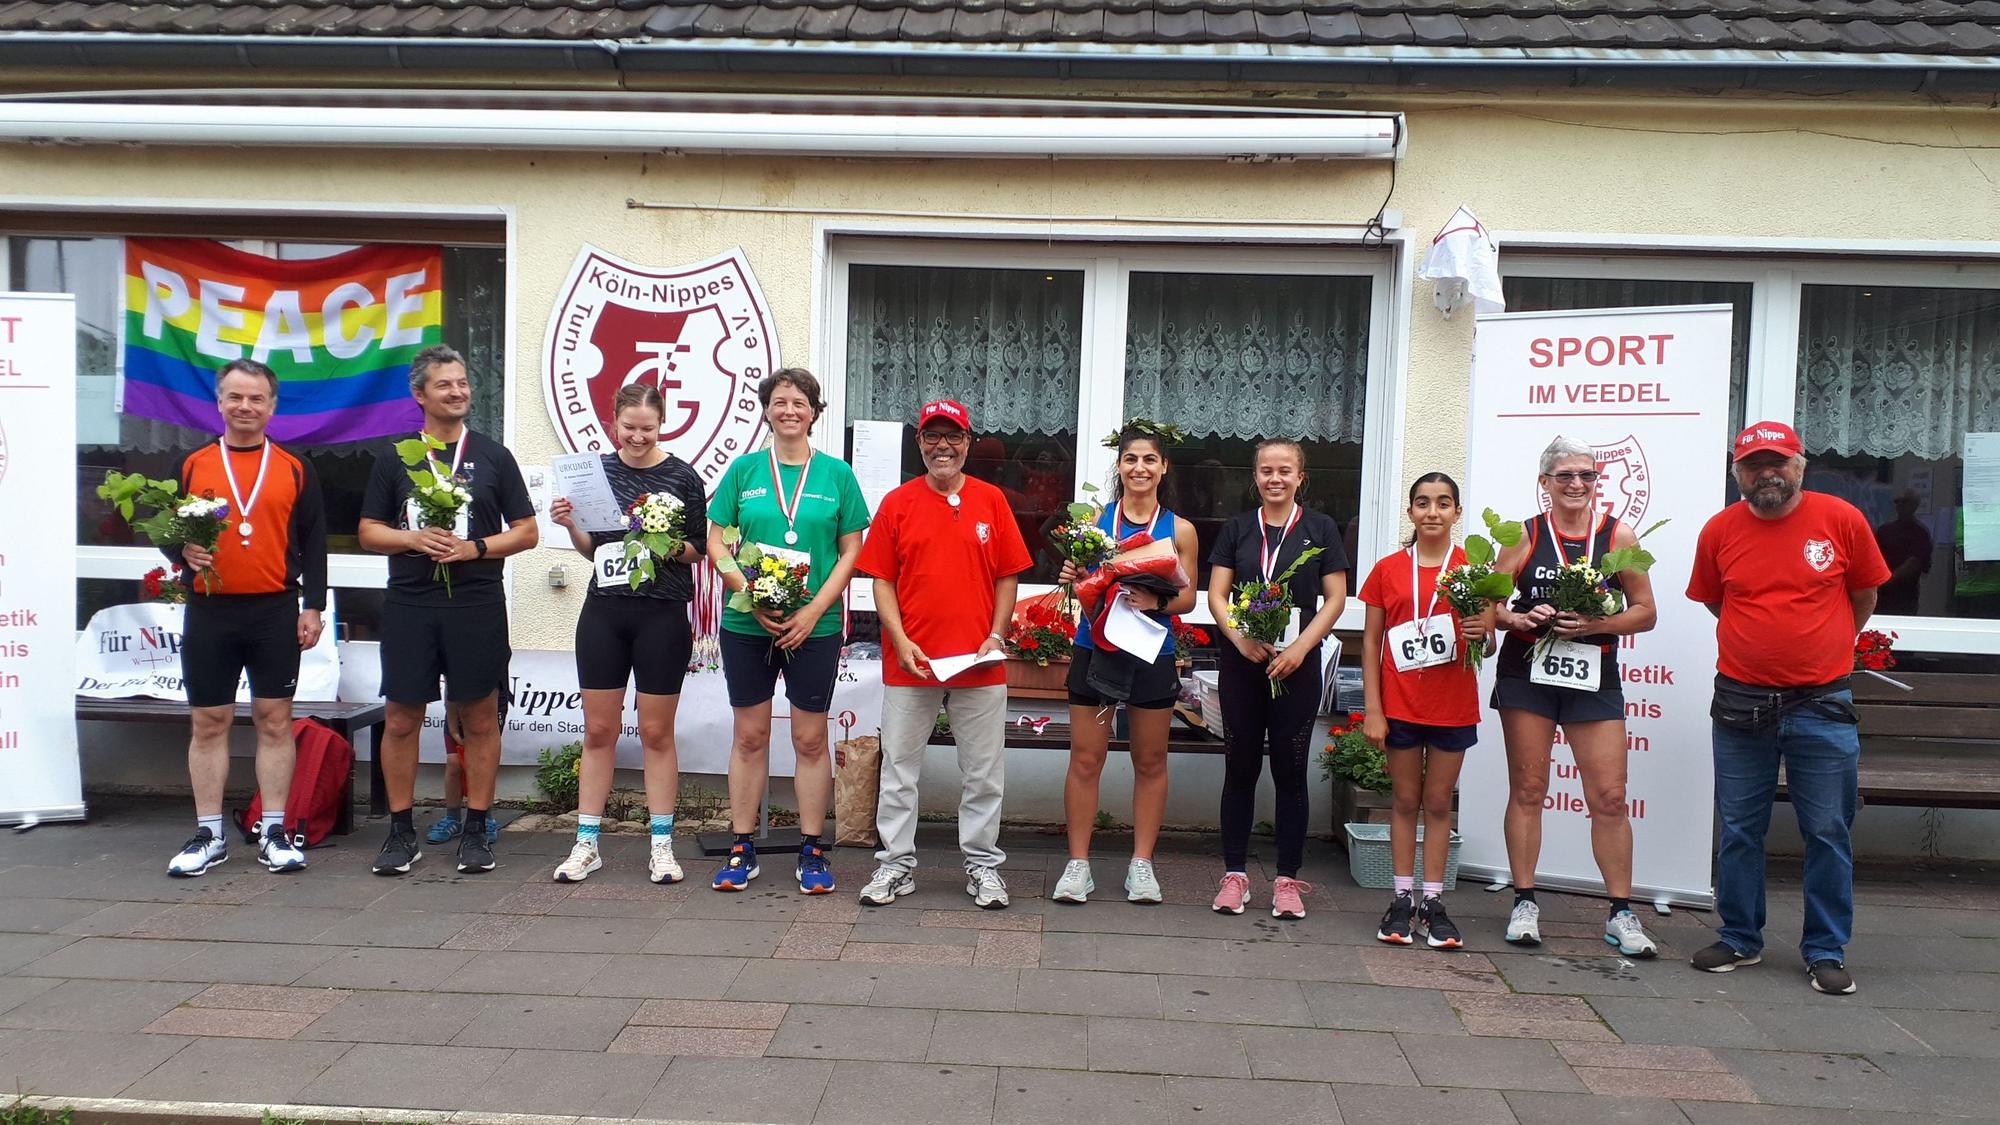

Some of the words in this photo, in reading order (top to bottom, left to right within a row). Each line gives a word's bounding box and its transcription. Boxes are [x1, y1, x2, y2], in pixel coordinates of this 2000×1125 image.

[588, 266, 735, 308] Köln-Nippes
[141, 260, 428, 363] PEACE
[1528, 334, 1674, 368] SPORT
[734, 366, 763, 425] 1878
[1528, 385, 1556, 404] IM
[1564, 383, 1671, 403] VEEDEL
[1741, 433, 1755, 445] Für
[1756, 429, 1786, 441] Nippes
[559, 460, 594, 473] URKUNDE
[1628, 489, 1647, 519] 1878
[603, 556, 640, 577] 624
[99, 630, 131, 654] Für
[140, 624, 184, 654] Nip
[1543, 655, 1590, 681] 653
[77, 676, 117, 690] Der
[508, 719, 526, 731] für
[529, 720, 553, 733] den
